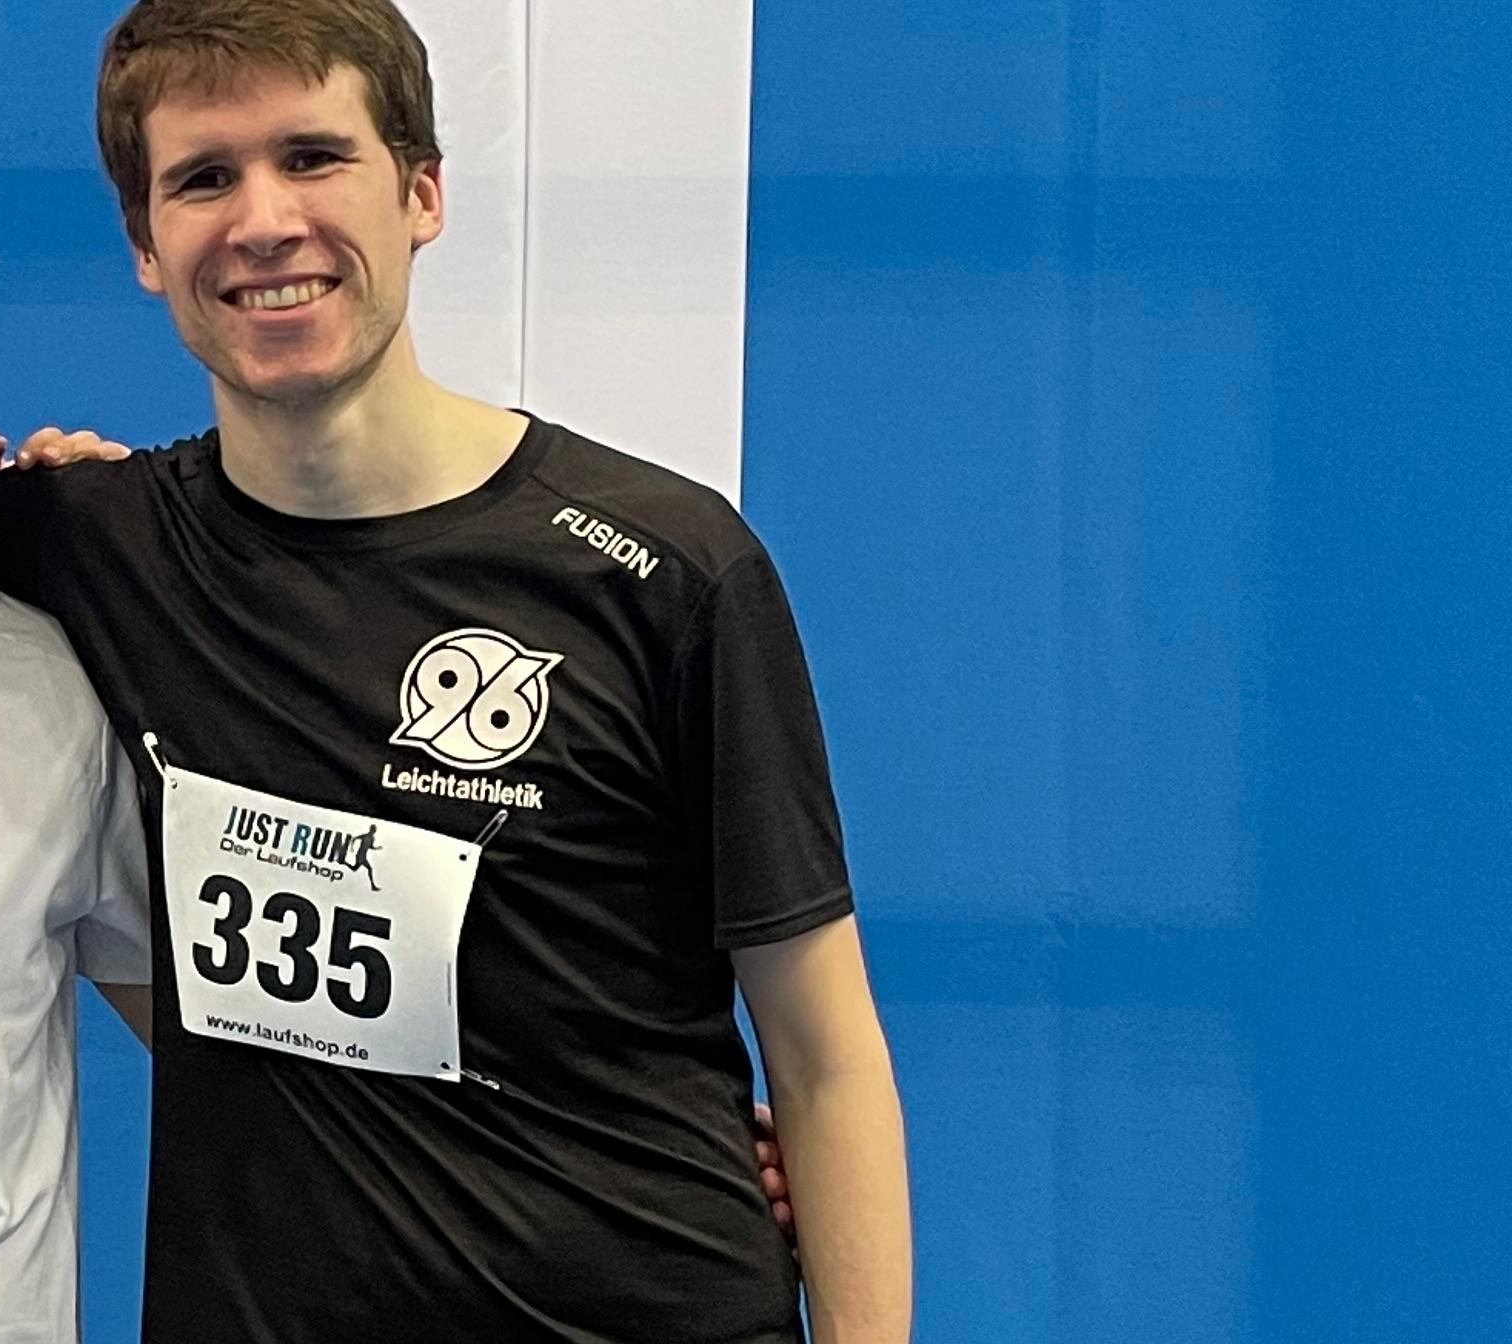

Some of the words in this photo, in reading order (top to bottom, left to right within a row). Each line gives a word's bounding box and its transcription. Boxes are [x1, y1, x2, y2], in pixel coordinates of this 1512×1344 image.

[552, 506, 659, 579] FUSION
[397, 641, 553, 752] 96
[381, 763, 544, 811] Leichtathletik
[220, 837, 255, 858] Der
[256, 848, 344, 882] Laufshop
[225, 806, 289, 849] JUST
[292, 823, 353, 864] RUN
[192, 874, 392, 1019] 335
[206, 1013, 369, 1061] www.laufshop.de
